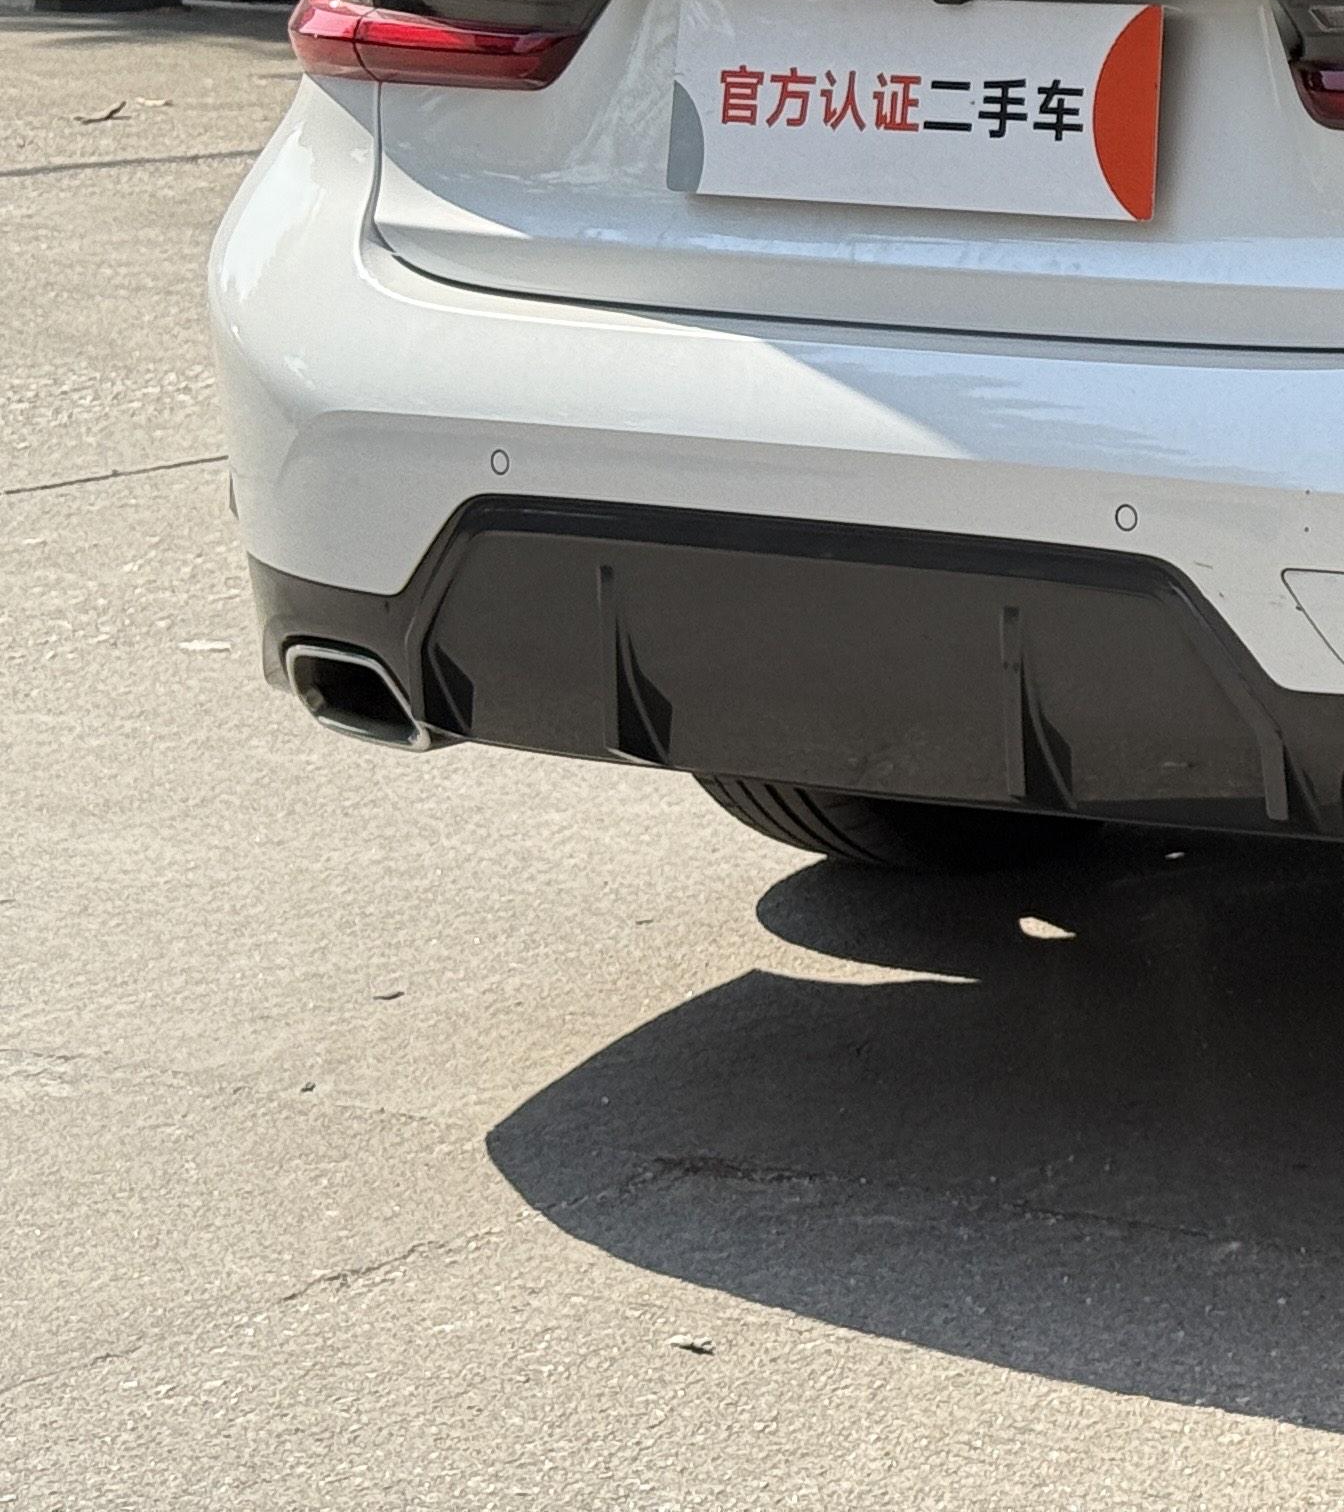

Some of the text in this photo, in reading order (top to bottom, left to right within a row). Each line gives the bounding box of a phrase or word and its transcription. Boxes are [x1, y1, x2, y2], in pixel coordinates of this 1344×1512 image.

[719, 64, 1085, 142] 官方认证二手车
